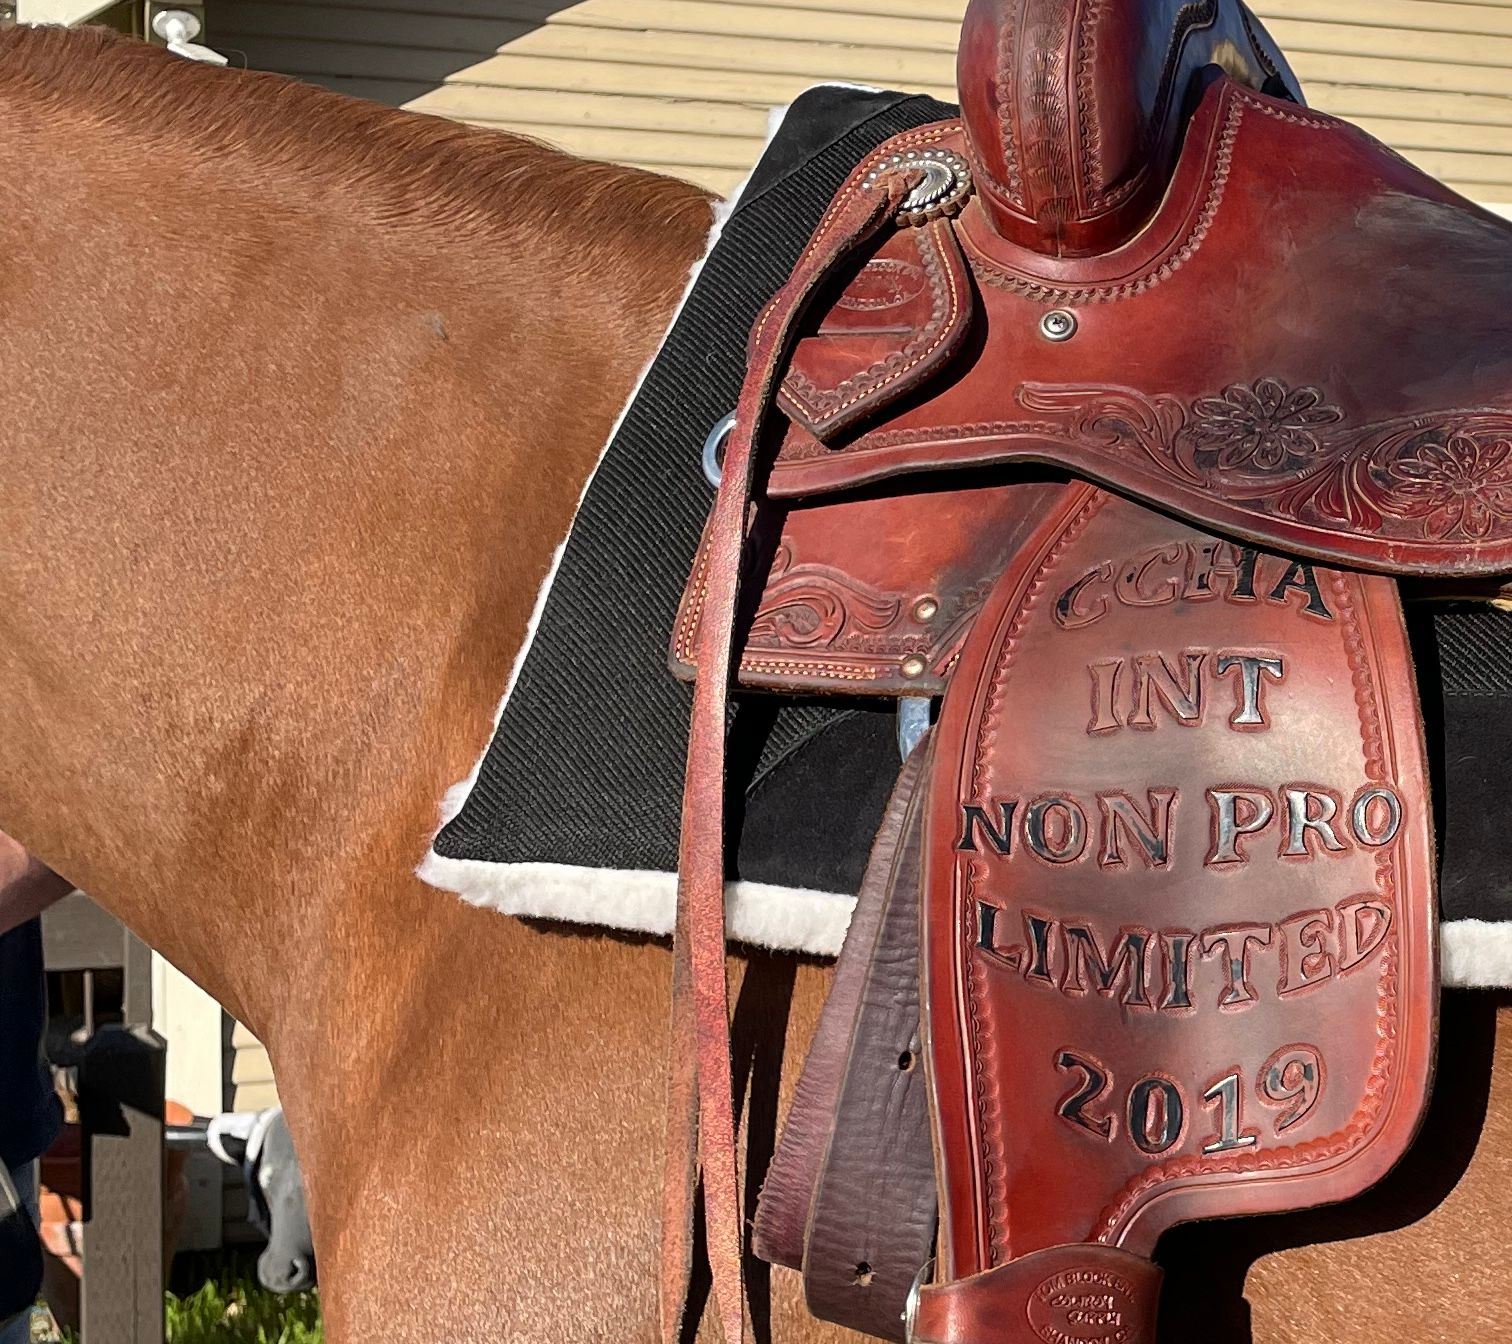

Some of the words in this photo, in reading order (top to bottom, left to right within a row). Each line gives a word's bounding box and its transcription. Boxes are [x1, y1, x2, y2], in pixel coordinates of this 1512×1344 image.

[1054, 540, 1334, 628] CCHA
[1086, 653, 1284, 733] INT
[961, 791, 1175, 867] NON
[1205, 787, 1402, 867] PRO
[975, 897, 1391, 1011] LIMITED
[1056, 1046, 1321, 1156] 2019
